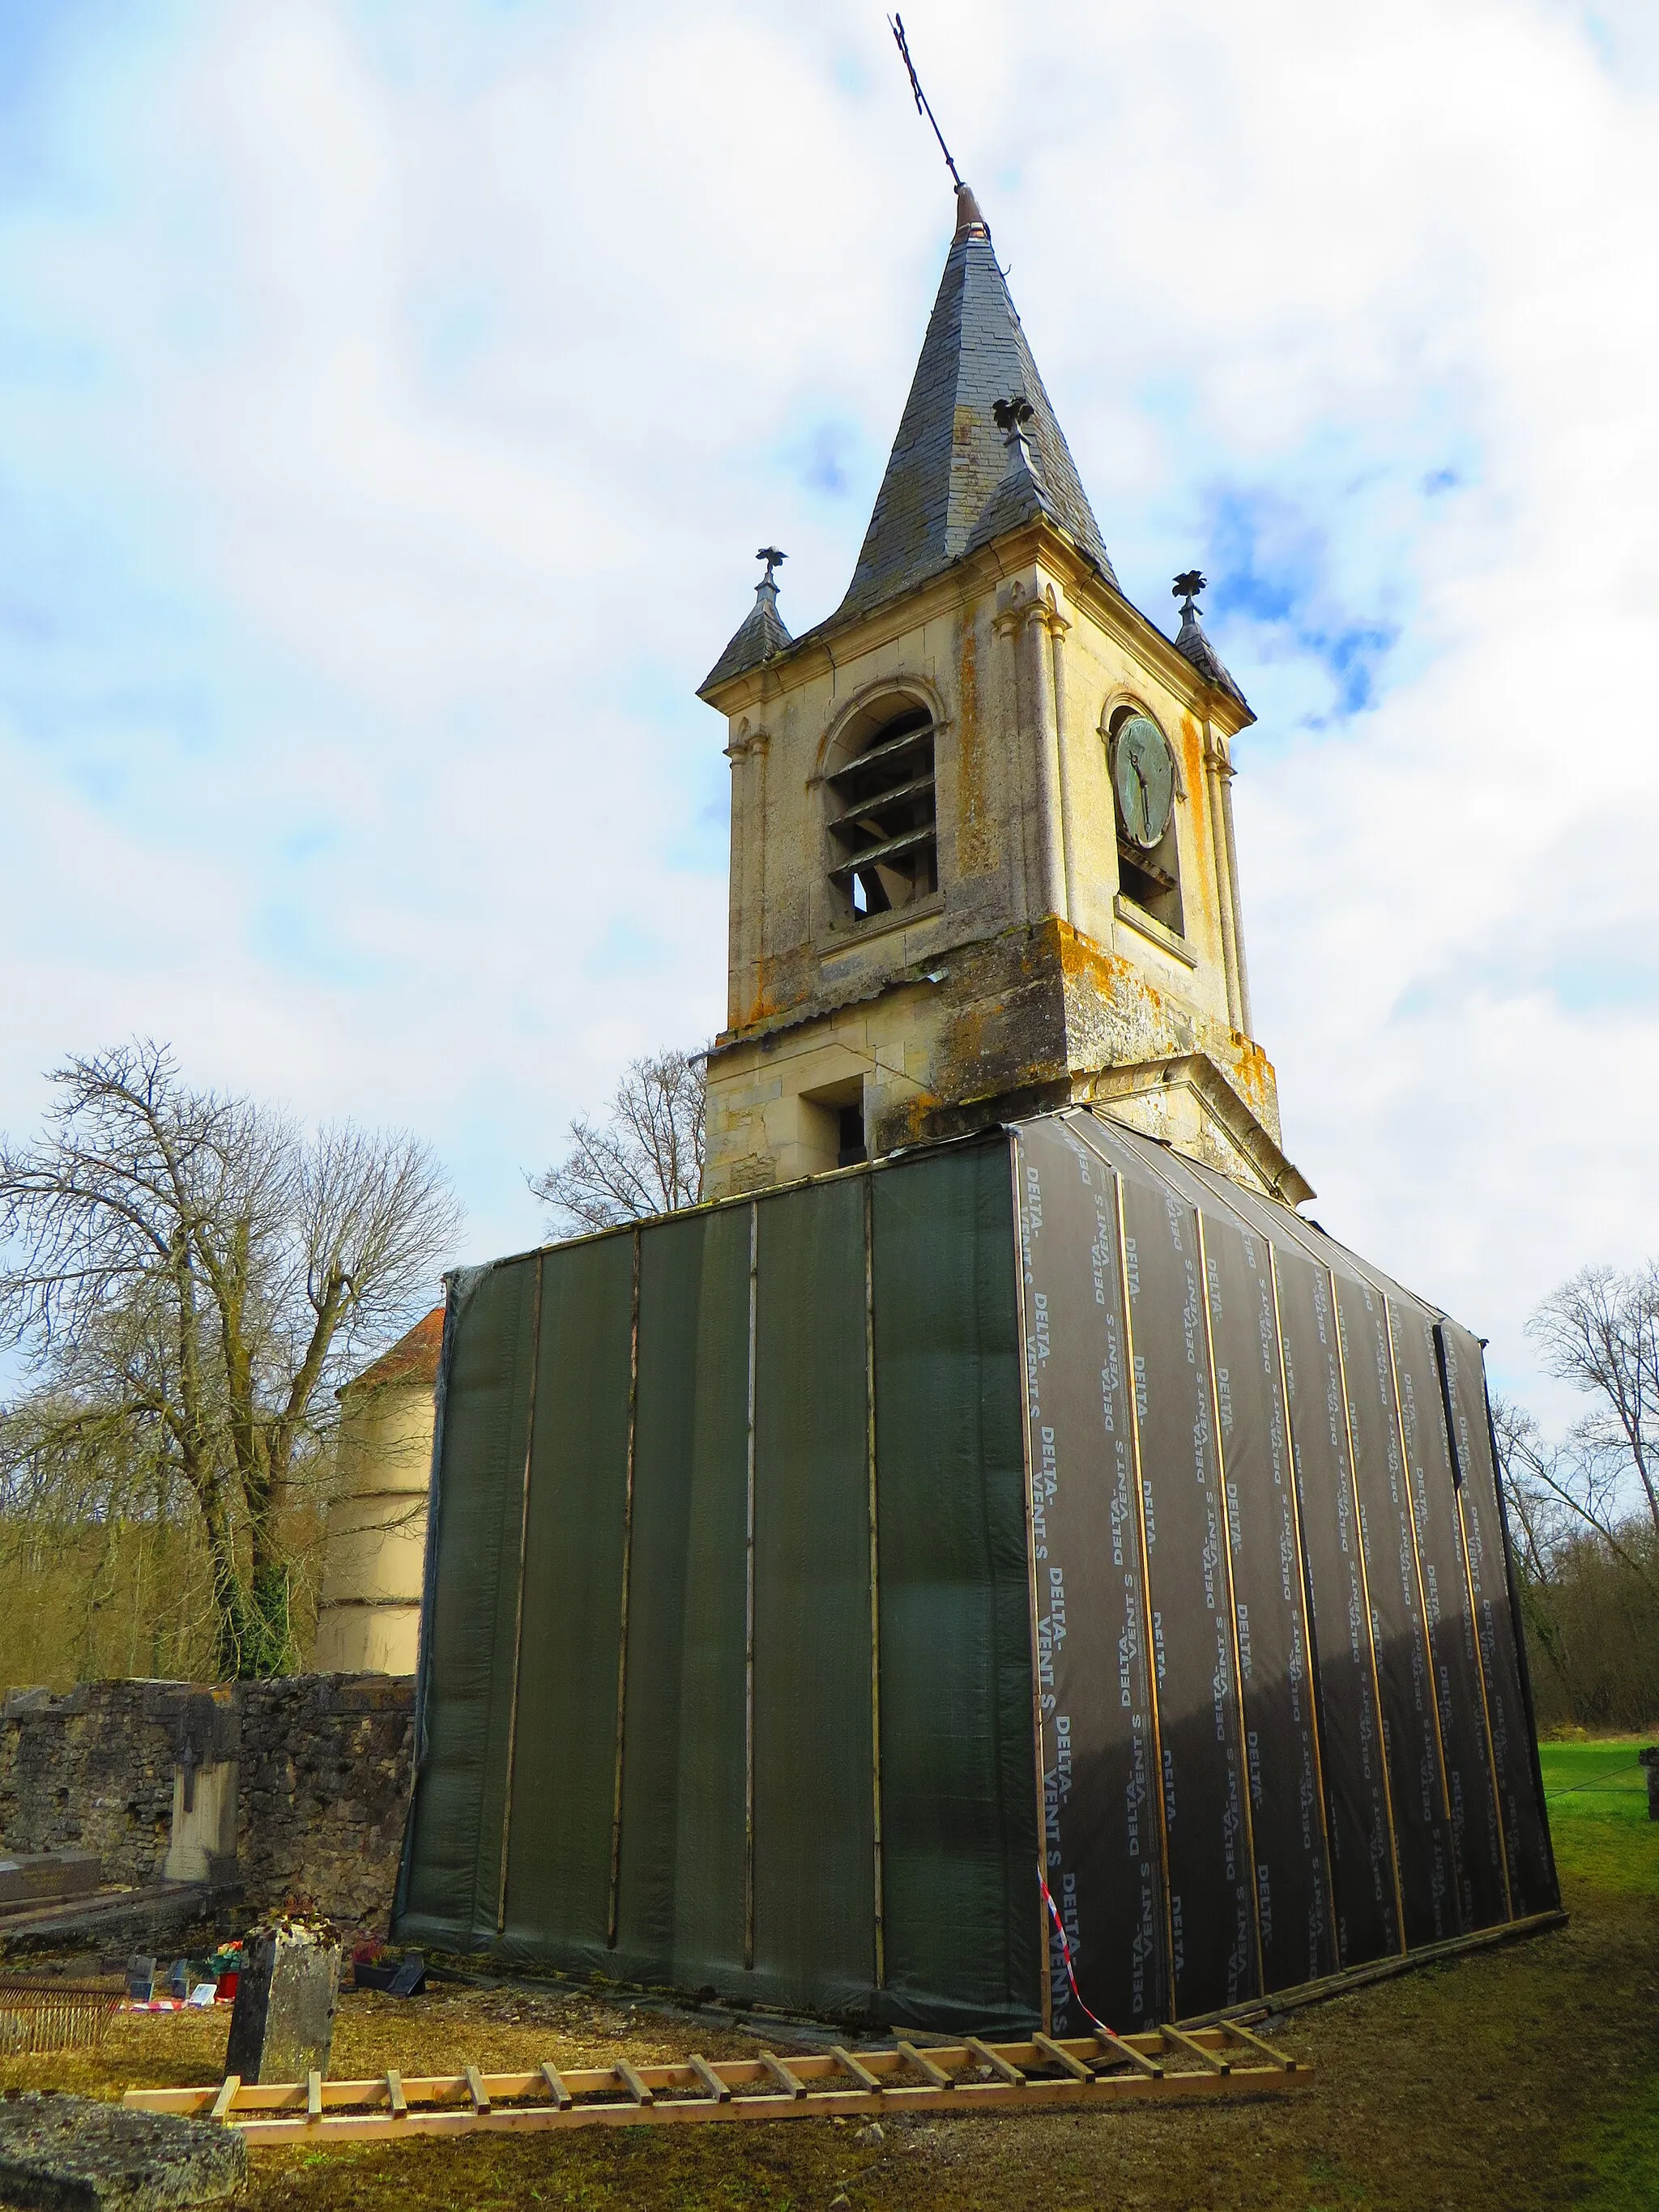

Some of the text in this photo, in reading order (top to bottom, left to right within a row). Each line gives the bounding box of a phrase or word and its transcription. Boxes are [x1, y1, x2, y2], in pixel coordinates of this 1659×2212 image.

[1026, 1166, 1043, 1238] DELTA-
[1094, 1194, 1109, 1266] VENT S
[1091, 1236, 1105, 1305] DELTA-
[1127, 1237, 1141, 1304] DELTA-
[1185, 1259, 1198, 1328] VENT S
[1259, 1279, 1273, 1339] VENT S
[1034, 1293, 1051, 1368] DELTA-
[1107, 1313, 1119, 1391] VENT S
[1183, 1298, 1195, 1364] DELTA-
[1027, 1336, 1040, 1418] VENT S
[1101, 1358, 1115, 1432] DELTA-
[1134, 1356, 1148, 1426] DELTA-
[1196, 1372, 1208, 1445] VENT S
[1273, 1383, 1282, 1447] VENT S
[1041, 1426, 1058, 1506] DELTA-
[1115, 1440, 1128, 1521] VENT S
[1193, 1415, 1205, 1484] DELTA-
[1033, 1472, 1048, 1559] VENT S
[1110, 1490, 1123, 1566] DELTA-
[1143, 1481, 1157, 1554] DELTA-
[1206, 1491, 1218, 1567] VENT S
[1282, 1494, 1294, 1562] VENT S
[1049, 1567, 1067, 1651] DELTA-
[1202, 1536, 1214, 1609] DELTA-
[1124, 1574, 1137, 1659] VENT S
[1038, 1616, 1056, 1711] VENT S
[1119, 1626, 1131, 1707] DELTA-
[1216, 1617, 1228, 1696] VENT S
[1213, 1665, 1224, 1741] DELTA-
[1056, 1715, 1073, 1804] DELTA-
[1132, 1714, 1146, 1805] VENT S
[1226, 1748, 1239, 1832] VENT S
[1044, 1767, 1062, 1866] VENT S
[1127, 1769, 1140, 1856] DELTA-
[1223, 1800, 1235, 1880] DELTA-
[1063, 1873, 1081, 1967] DELTA-
[1141, 1863, 1153, 1958] VENT S
[1236, 1886, 1247, 1974] VENT S
[1133, 1924, 1144, 2014] DELTA-
